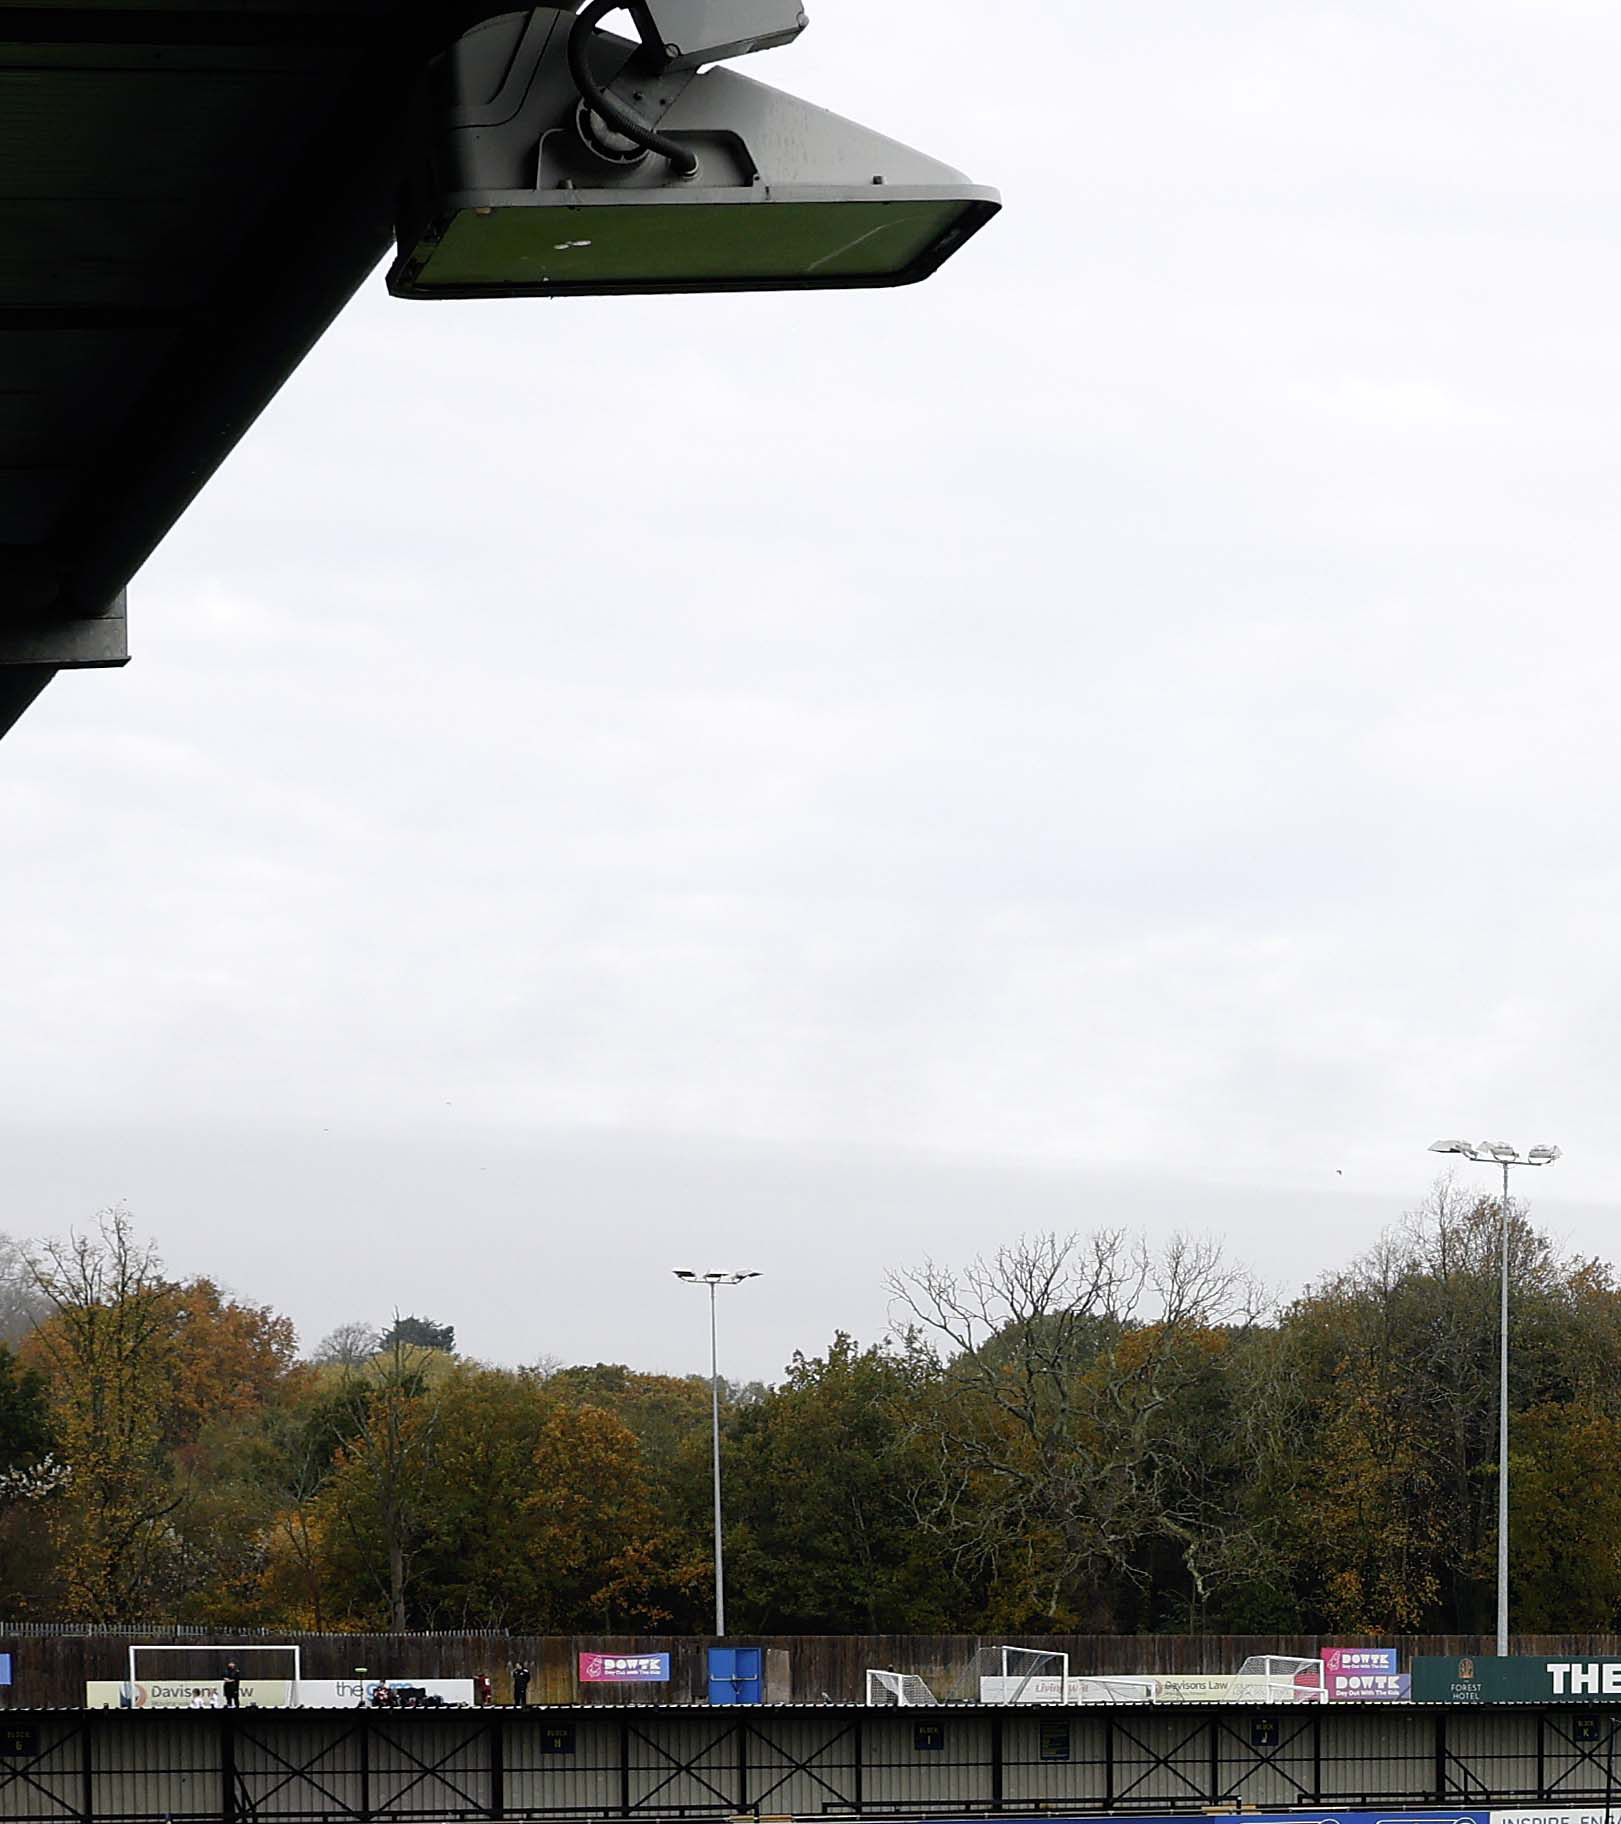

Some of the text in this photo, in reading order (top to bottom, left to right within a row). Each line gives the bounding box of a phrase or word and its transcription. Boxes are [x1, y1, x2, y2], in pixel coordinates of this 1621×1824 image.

[1342, 1654, 1389, 1664] DOWTK
[604, 1659, 661, 1670] DOWTK
[1209, 1681, 1228, 1690] Law
[1336, 1676, 1399, 1689] DOWTK
[337, 1681, 363, 1697] the
[1451, 1684, 1482, 1692] FOREST
[1453, 1692, 1480, 1700] HOTEL
